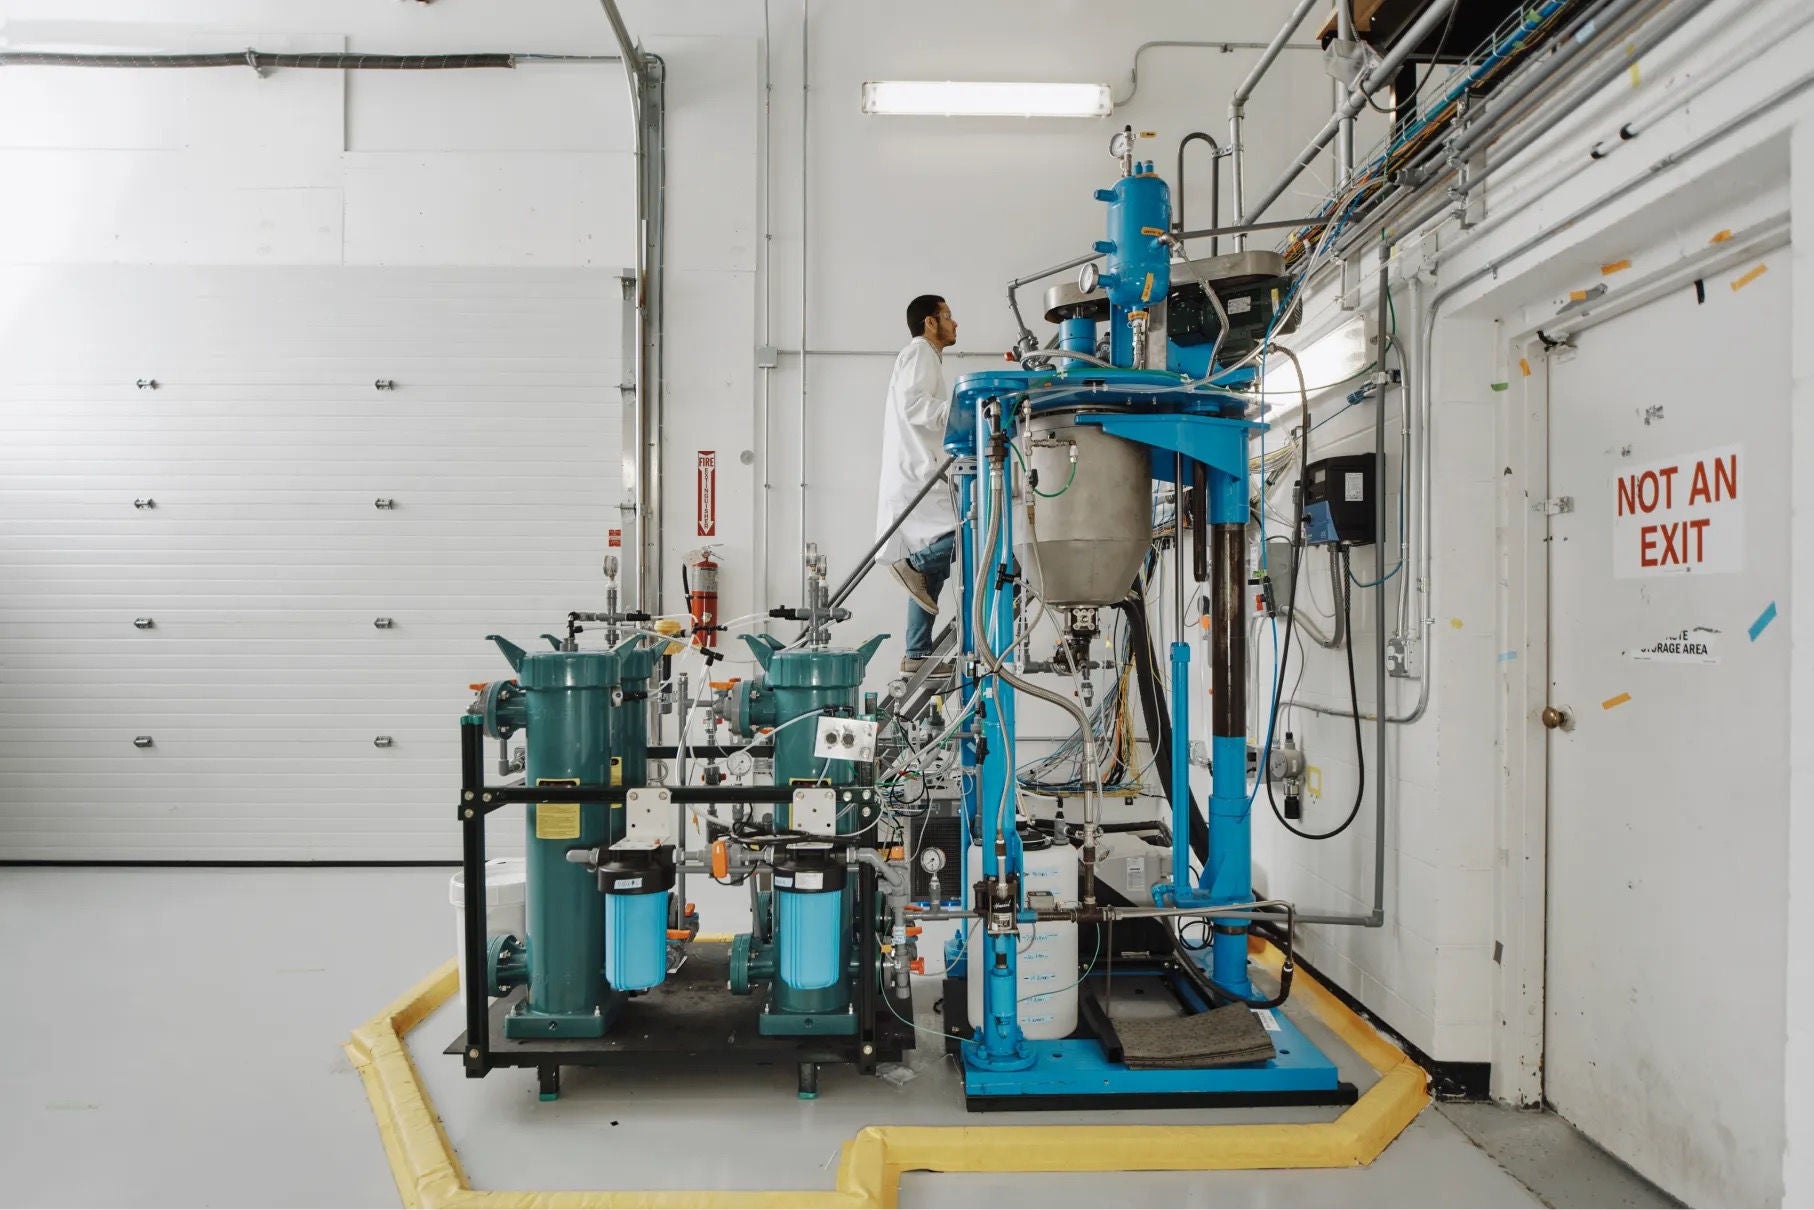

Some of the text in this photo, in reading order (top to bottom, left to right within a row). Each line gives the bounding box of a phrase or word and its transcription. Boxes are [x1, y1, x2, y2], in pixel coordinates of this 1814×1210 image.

[699, 457, 714, 467] FIRE
[1618, 455, 1736, 516] NOT AN
[1641, 518, 1710, 567] EXIT
[1641, 643, 1708, 655] ORAGE AREA
